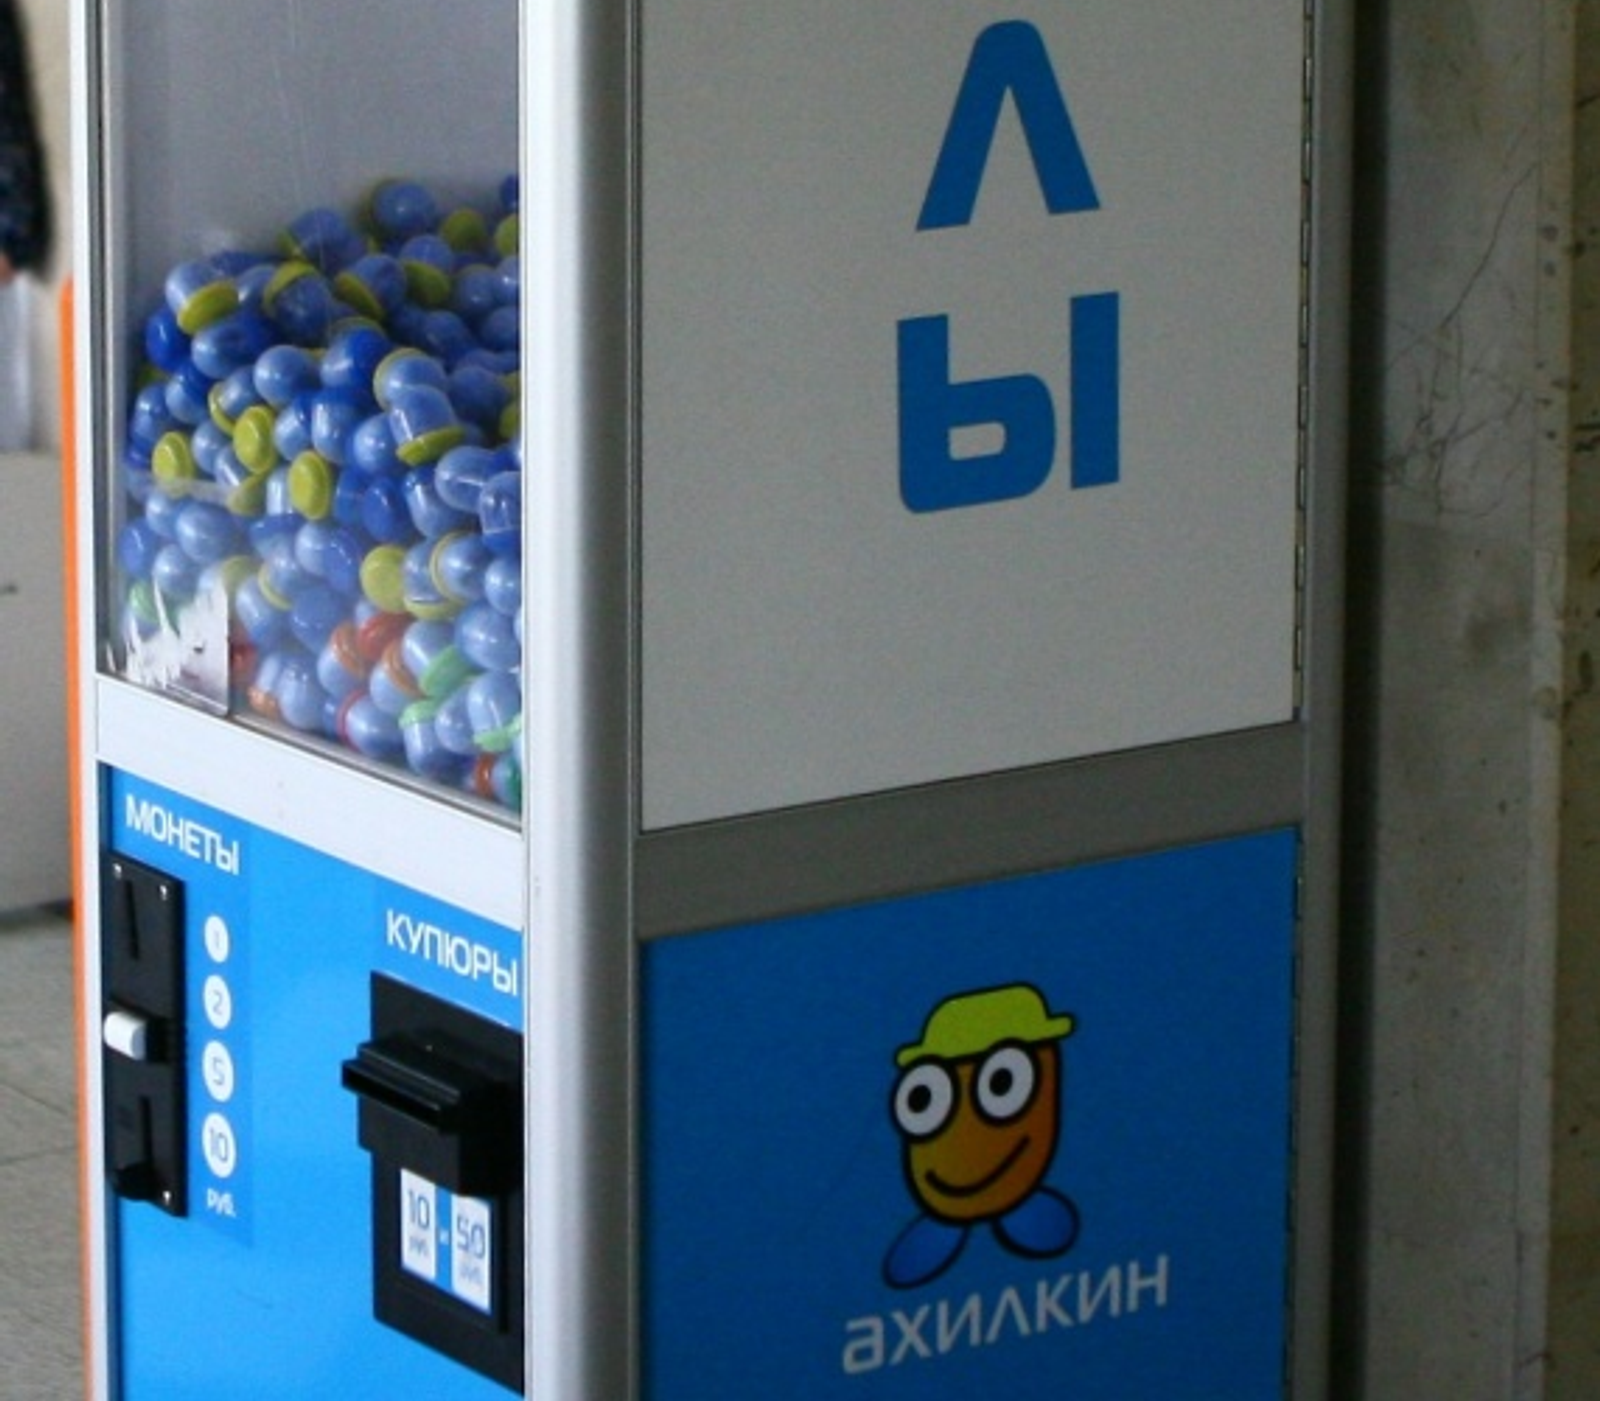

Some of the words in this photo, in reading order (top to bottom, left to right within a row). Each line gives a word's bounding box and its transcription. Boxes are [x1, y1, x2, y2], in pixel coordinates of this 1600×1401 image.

[126, 794, 239, 876] МОНЕТЫ
[386, 909, 518, 997] КУПЮРЫ
[407, 1188, 431, 1232] 10
[456, 1212, 487, 1261] 50
[842, 1254, 1169, 1374] ахилкин
